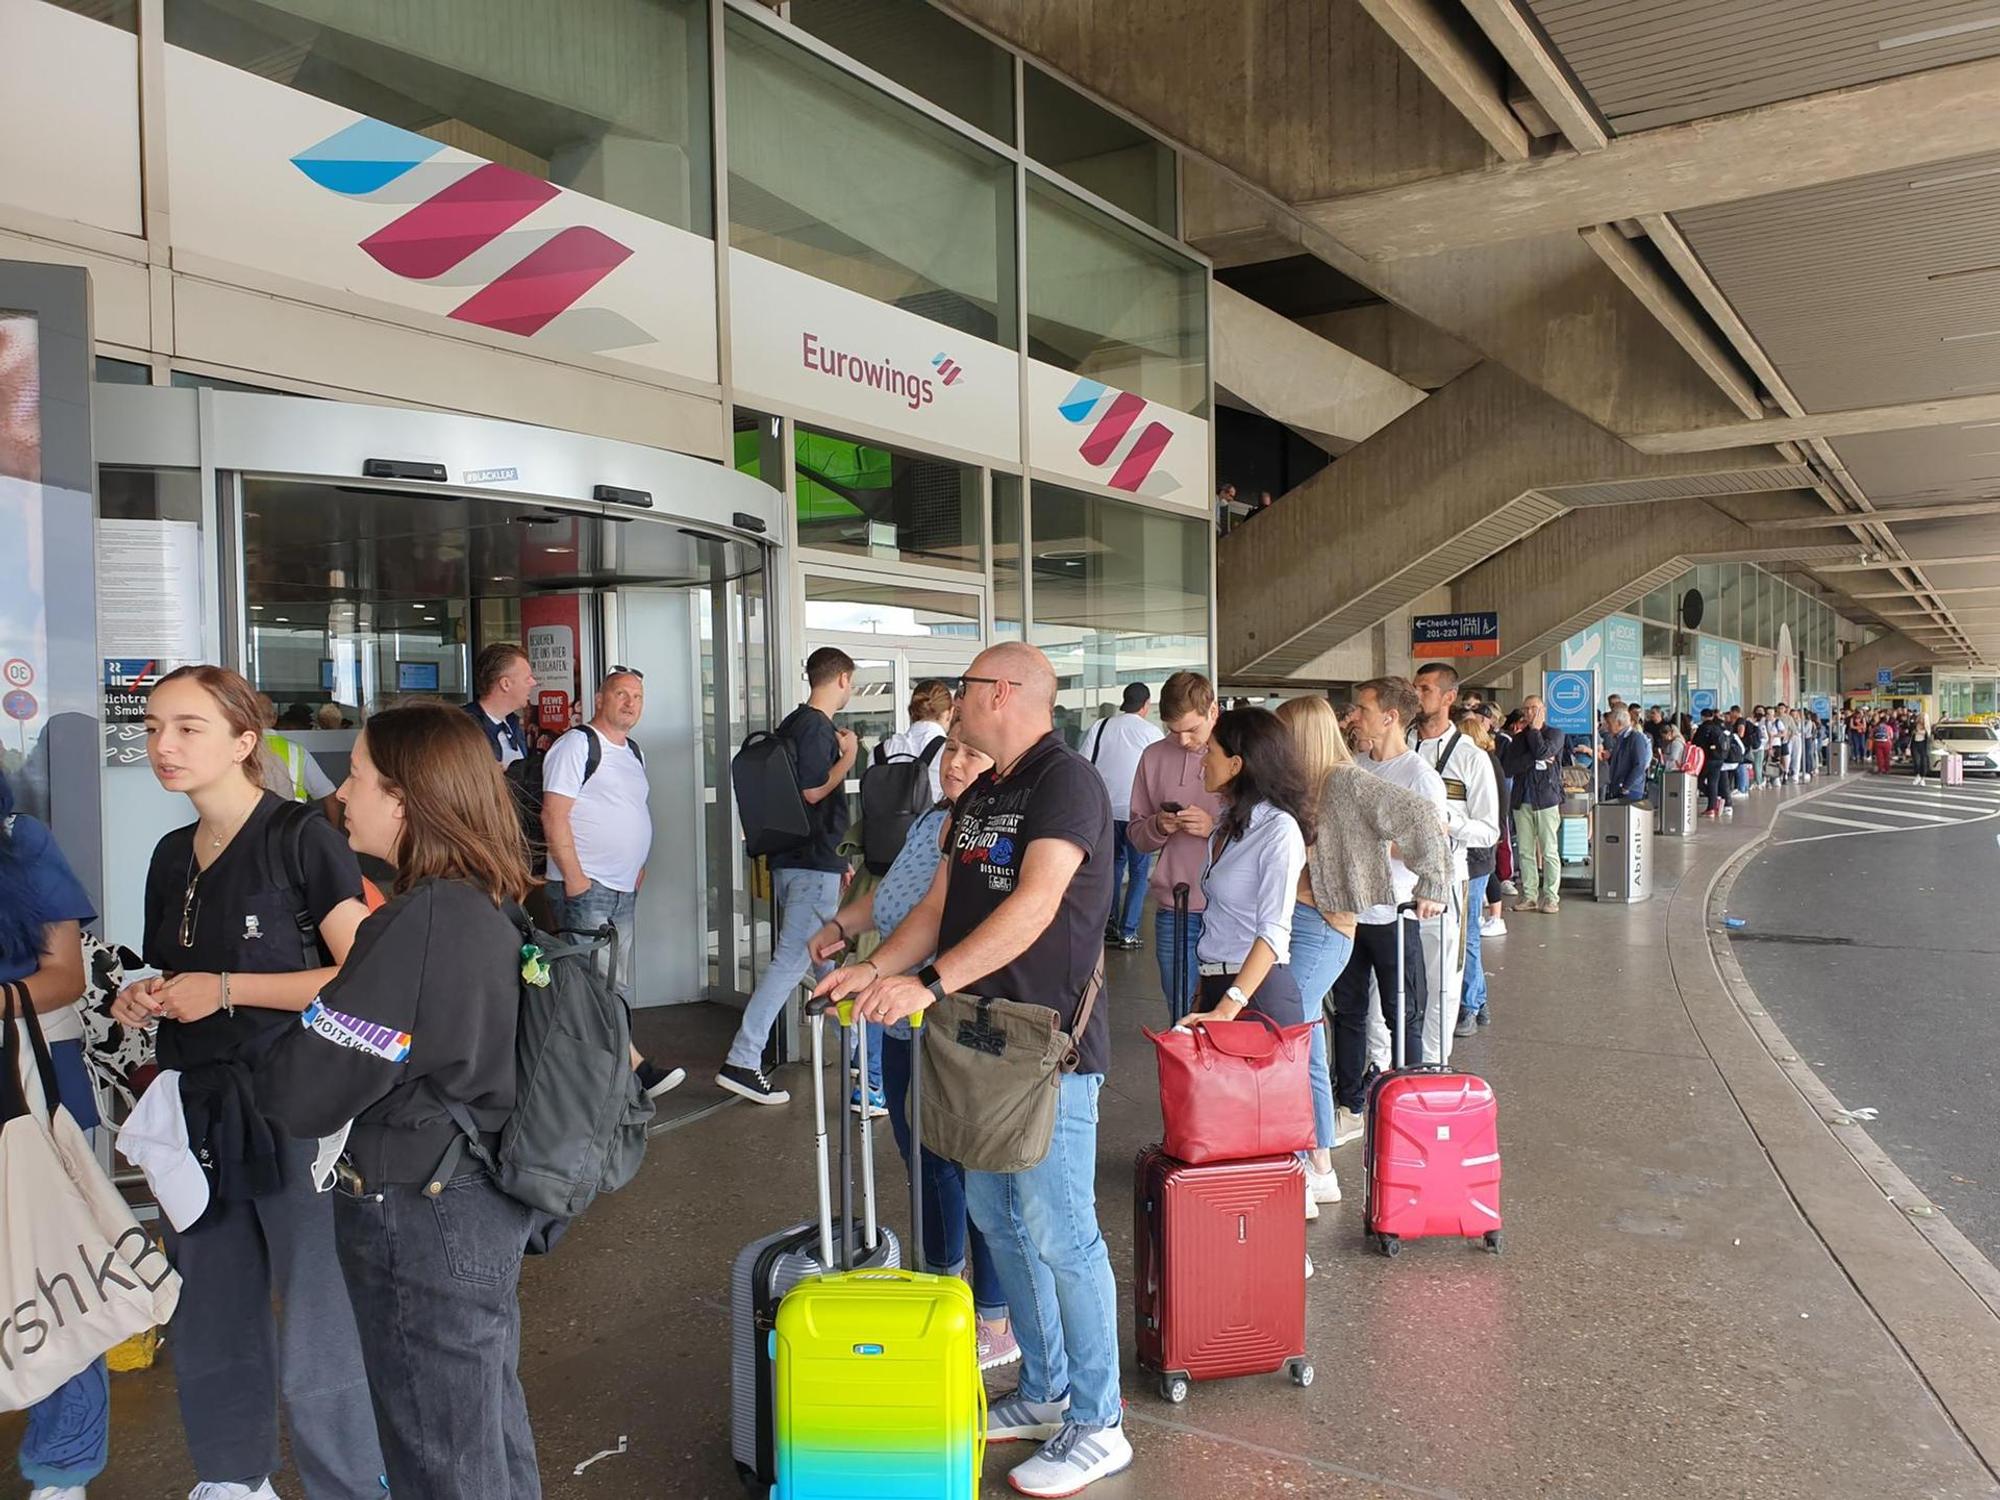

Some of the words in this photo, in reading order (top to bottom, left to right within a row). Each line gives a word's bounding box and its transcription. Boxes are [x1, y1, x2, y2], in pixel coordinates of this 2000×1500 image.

[803, 332, 933, 409] Eurowings
[1426, 618, 1460, 628] Check-in
[1426, 629, 1458, 638] 201-220
[105, 693, 147, 704] ichtra
[542, 696, 563, 705] REWE
[114, 705, 145, 716] Smok
[543, 705, 561, 714] CITY
[980, 863, 1015, 876] DISTRICT
